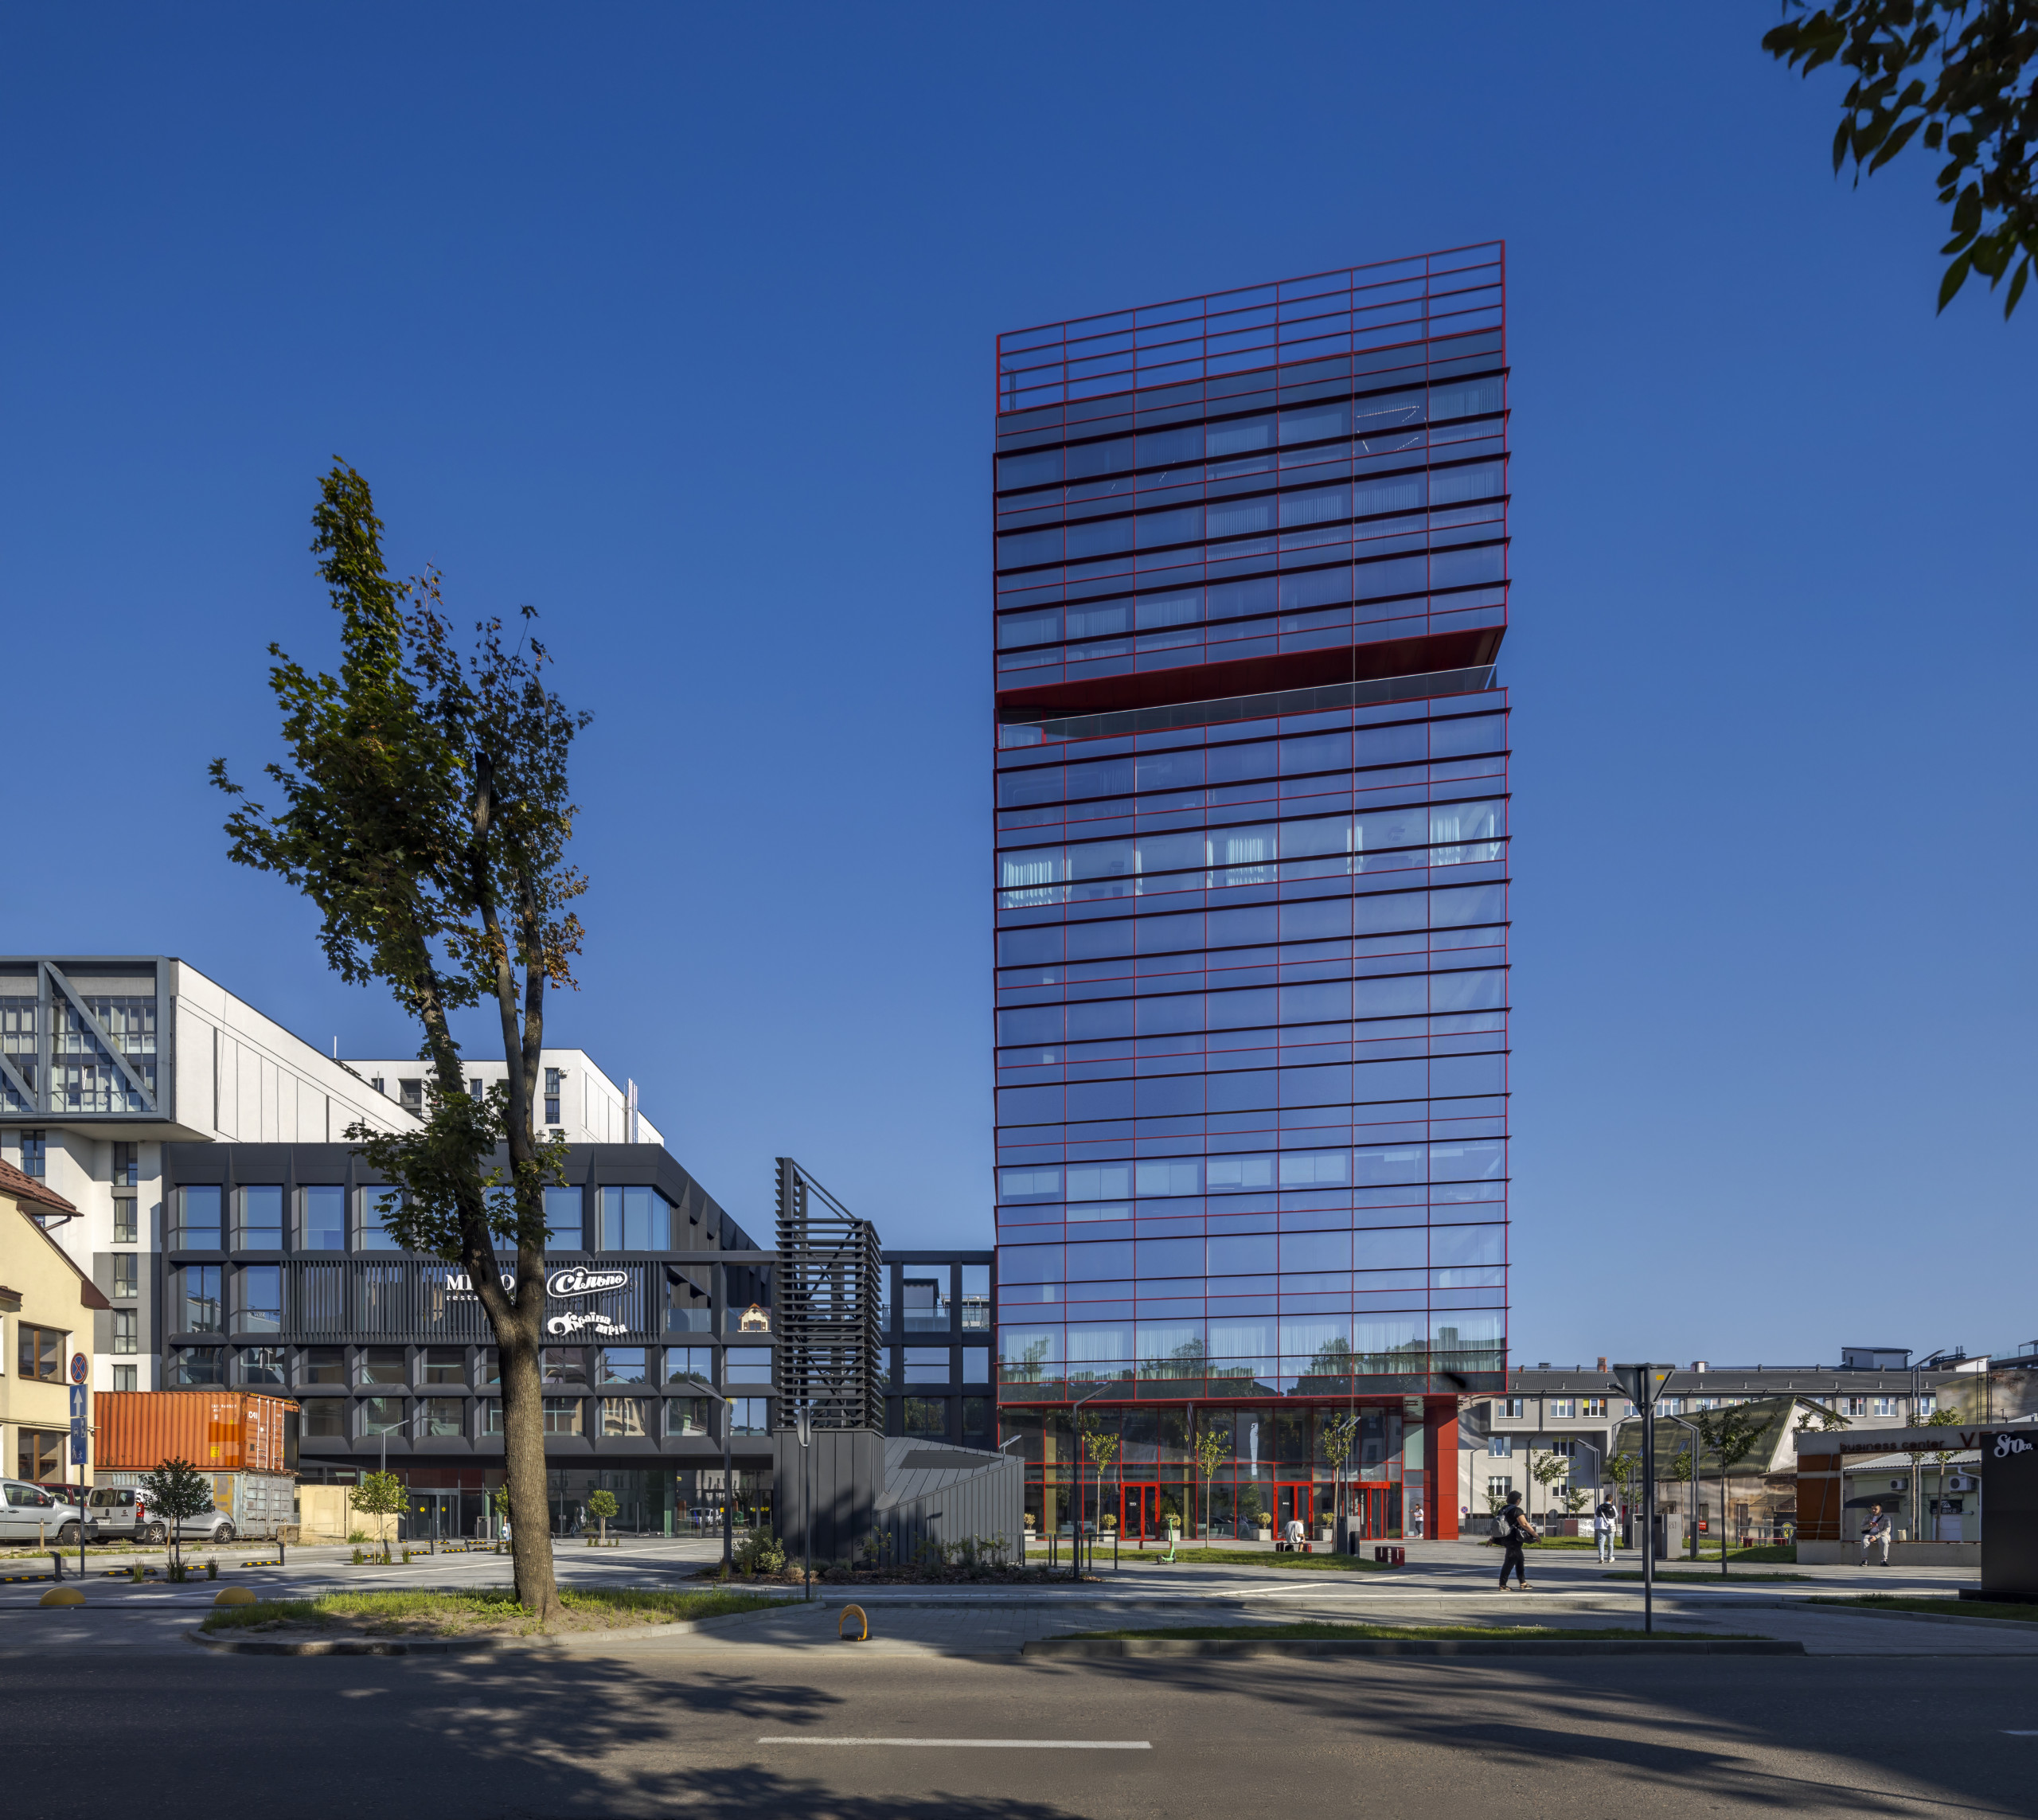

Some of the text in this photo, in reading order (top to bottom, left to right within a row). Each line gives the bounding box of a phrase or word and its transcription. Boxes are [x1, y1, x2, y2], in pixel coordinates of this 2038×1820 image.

[446, 1274, 515, 1291] MIO
[556, 1271, 623, 1293] Сільпо
[248, 1411, 258, 1420] CAI
[1840, 1439, 1945, 1451] business center
